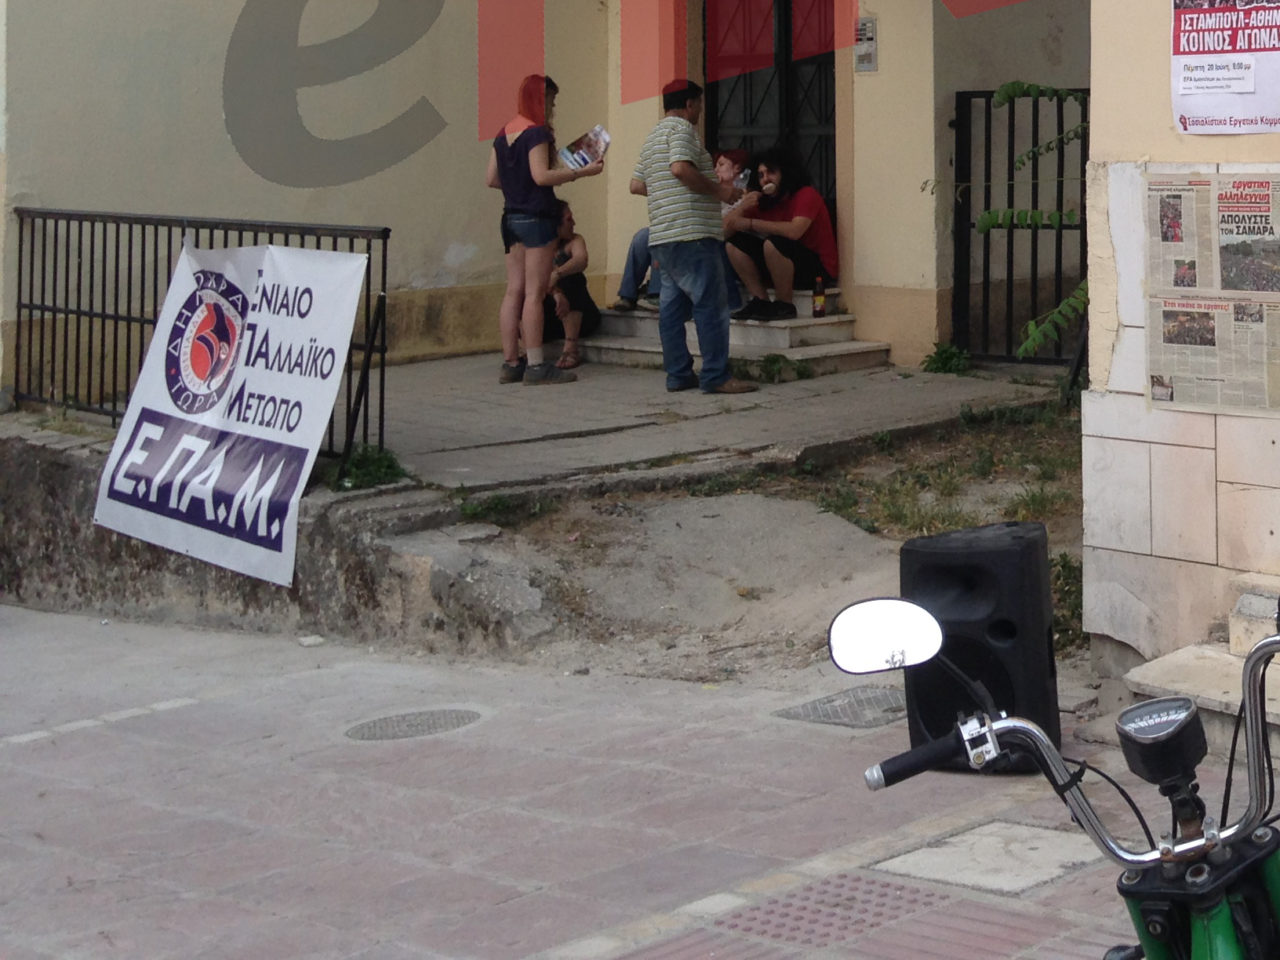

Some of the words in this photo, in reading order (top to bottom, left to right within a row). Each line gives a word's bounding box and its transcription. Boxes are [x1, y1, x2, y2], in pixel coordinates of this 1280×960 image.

[1180, 30, 1232, 52] ΚΟΙΝΟΣ
[1220, 214, 1271, 225] ΑΠΟΛΥΣΤΕ
[1235, 225, 1275, 236] ΣΑΜΑΡΑ
